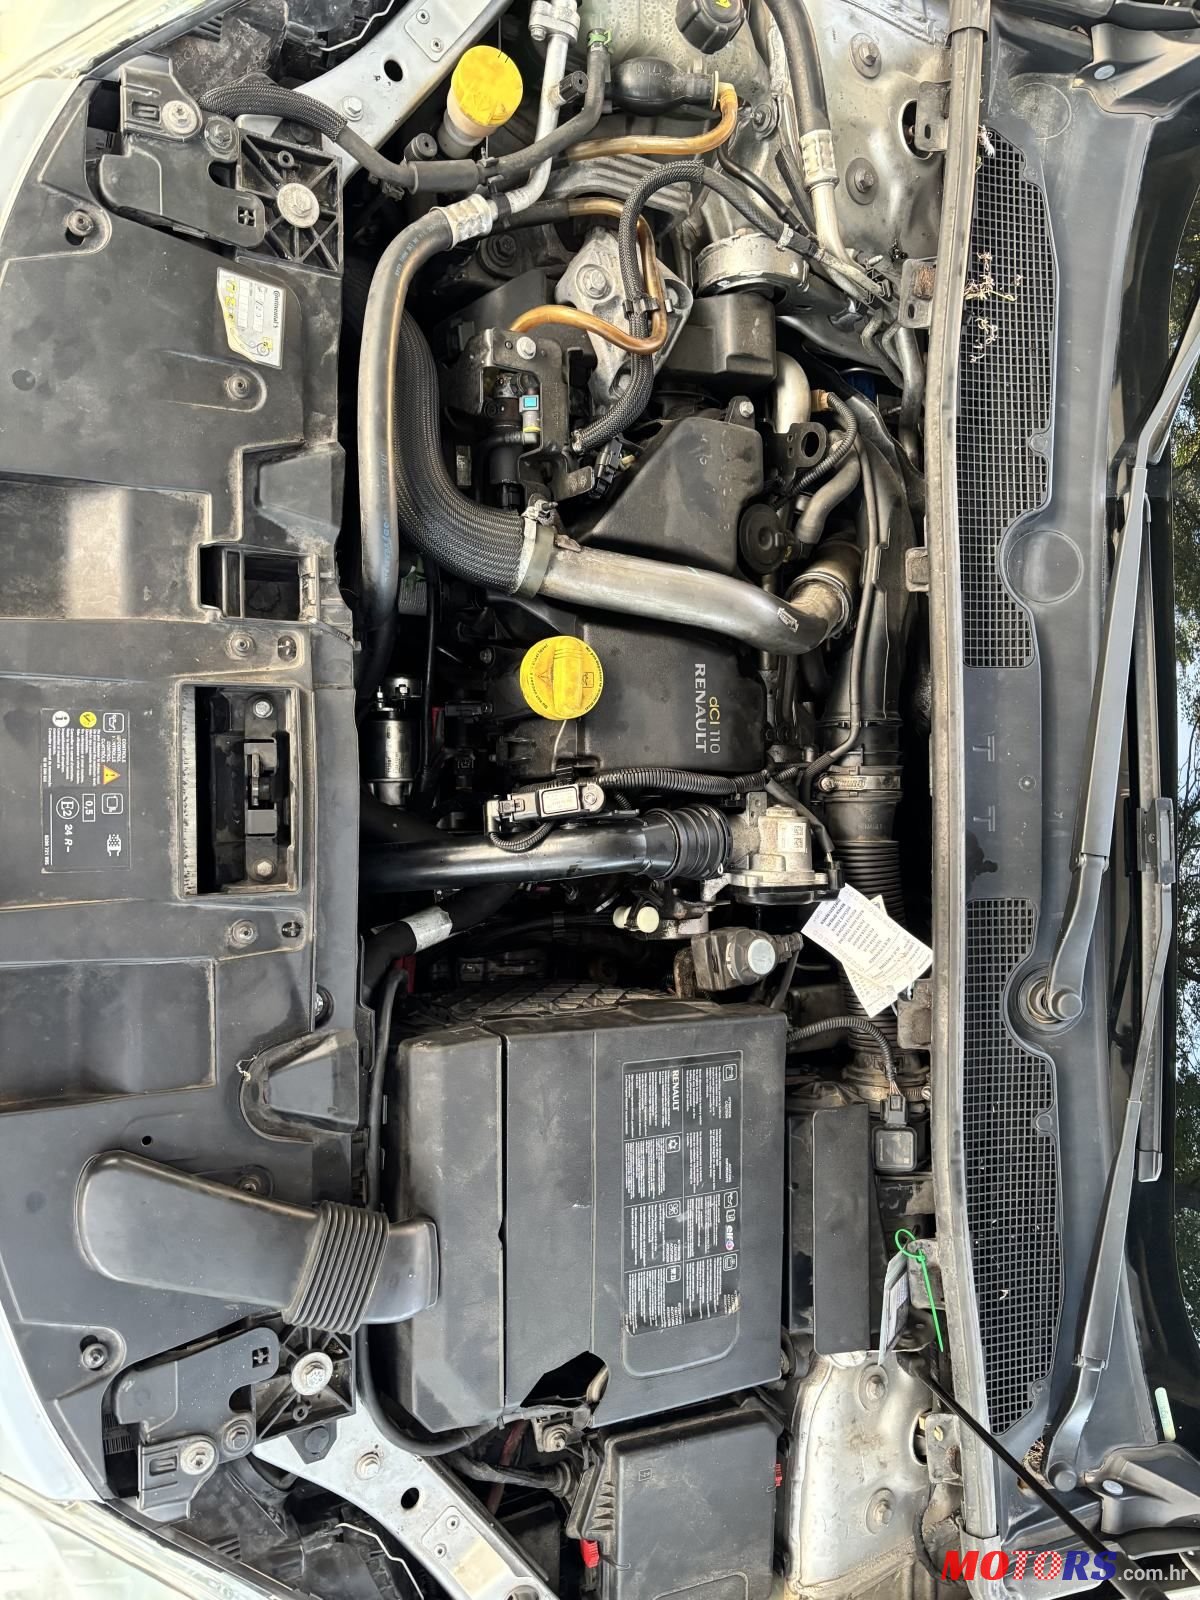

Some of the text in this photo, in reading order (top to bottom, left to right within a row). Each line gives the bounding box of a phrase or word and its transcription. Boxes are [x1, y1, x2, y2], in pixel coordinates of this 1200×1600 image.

[695, 664, 706, 754] RENAULT
[710, 730, 720, 754] 110
[61, 801, 74, 816] E2
[84, 800, 94, 815] 0,5
[64, 824, 72, 836] 24
[726, 1225, 734, 1242] elf
